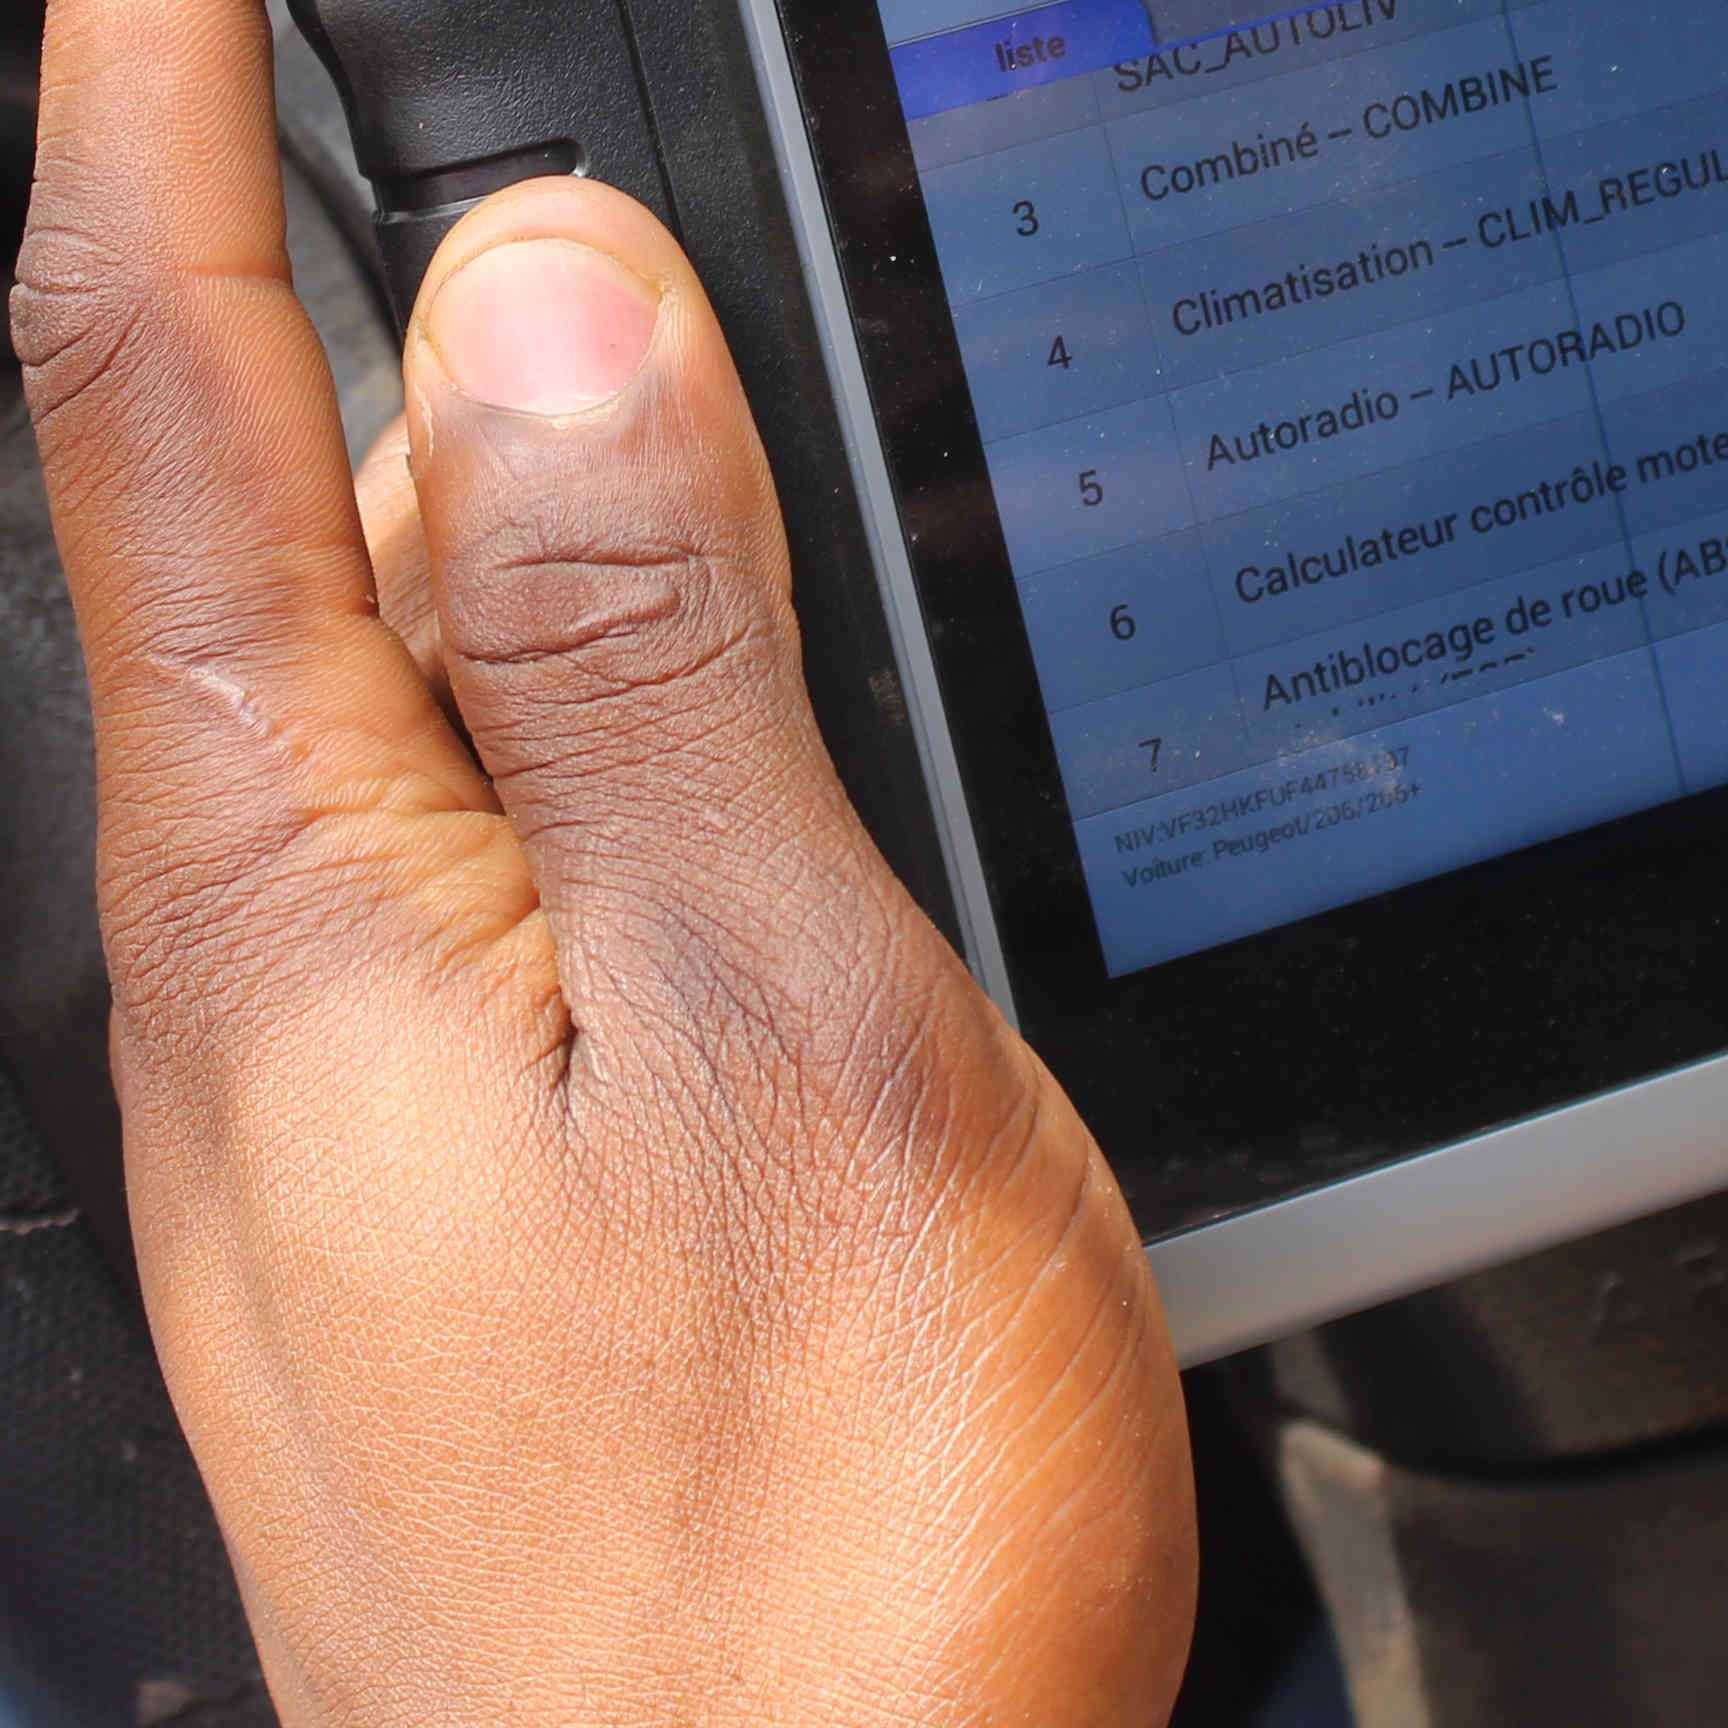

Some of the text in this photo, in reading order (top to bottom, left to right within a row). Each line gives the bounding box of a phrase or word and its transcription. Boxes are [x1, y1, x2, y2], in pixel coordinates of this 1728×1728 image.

[994, 31, 1067, 73] liste
[1012, 201, 1041, 238] 3
[1141, 121, 1318, 200] Combiné
[1364, 56, 1557, 140] COMBINE
[1046, 335, 1073, 372] 4
[1172, 237, 1435, 338] Climatisation
[1078, 470, 1105, 507] 5
[1206, 386, 1401, 470] Autoradio
[1446, 301, 1686, 399] AUTORADIO
[1110, 604, 1136, 640] 6
[1234, 511, 1459, 604] Calculateur
[1469, 463, 1628, 534] contrôle
[1138, 737, 1165, 773] 7
[1261, 612, 1497, 711] Antiblocage
[1505, 597, 1555, 635] de
[1561, 569, 1649, 621] roue
[1122, 849, 1208, 889] Voiture:
